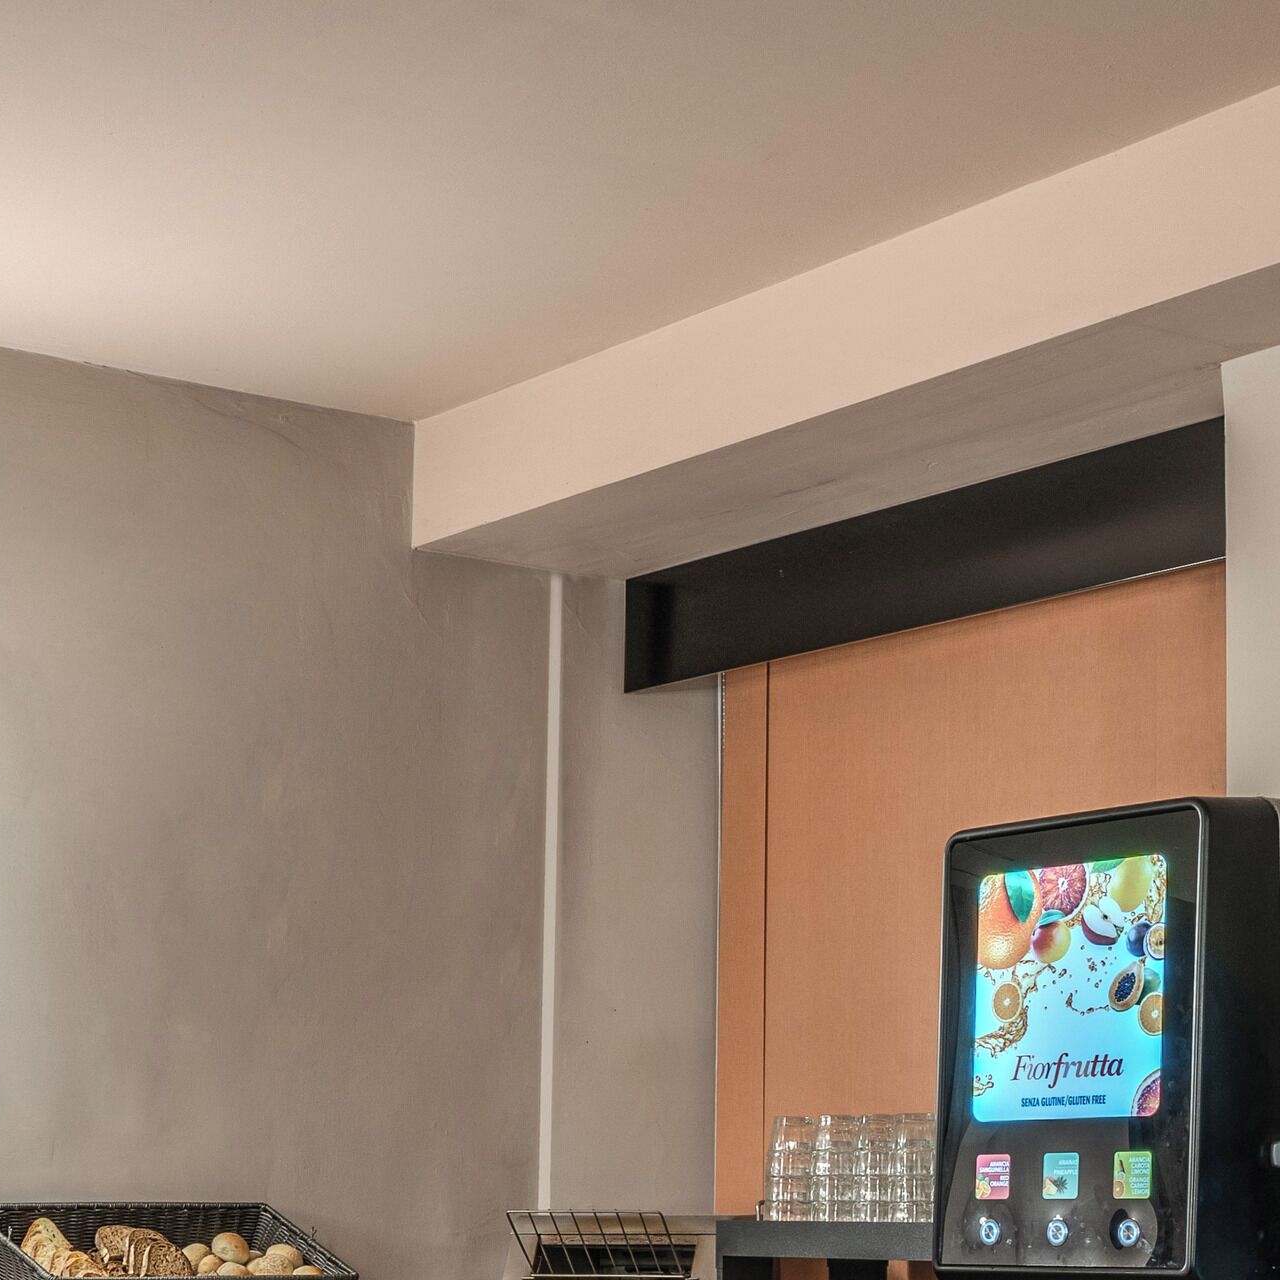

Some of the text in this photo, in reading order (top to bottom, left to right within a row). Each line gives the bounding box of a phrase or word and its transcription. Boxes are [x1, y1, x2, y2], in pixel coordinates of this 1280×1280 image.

[1010, 1053, 1124, 1088] Fiorfrutta
[1021, 1095, 1107, 1107] SENZA GLUTINE/GLUTEN FREE
